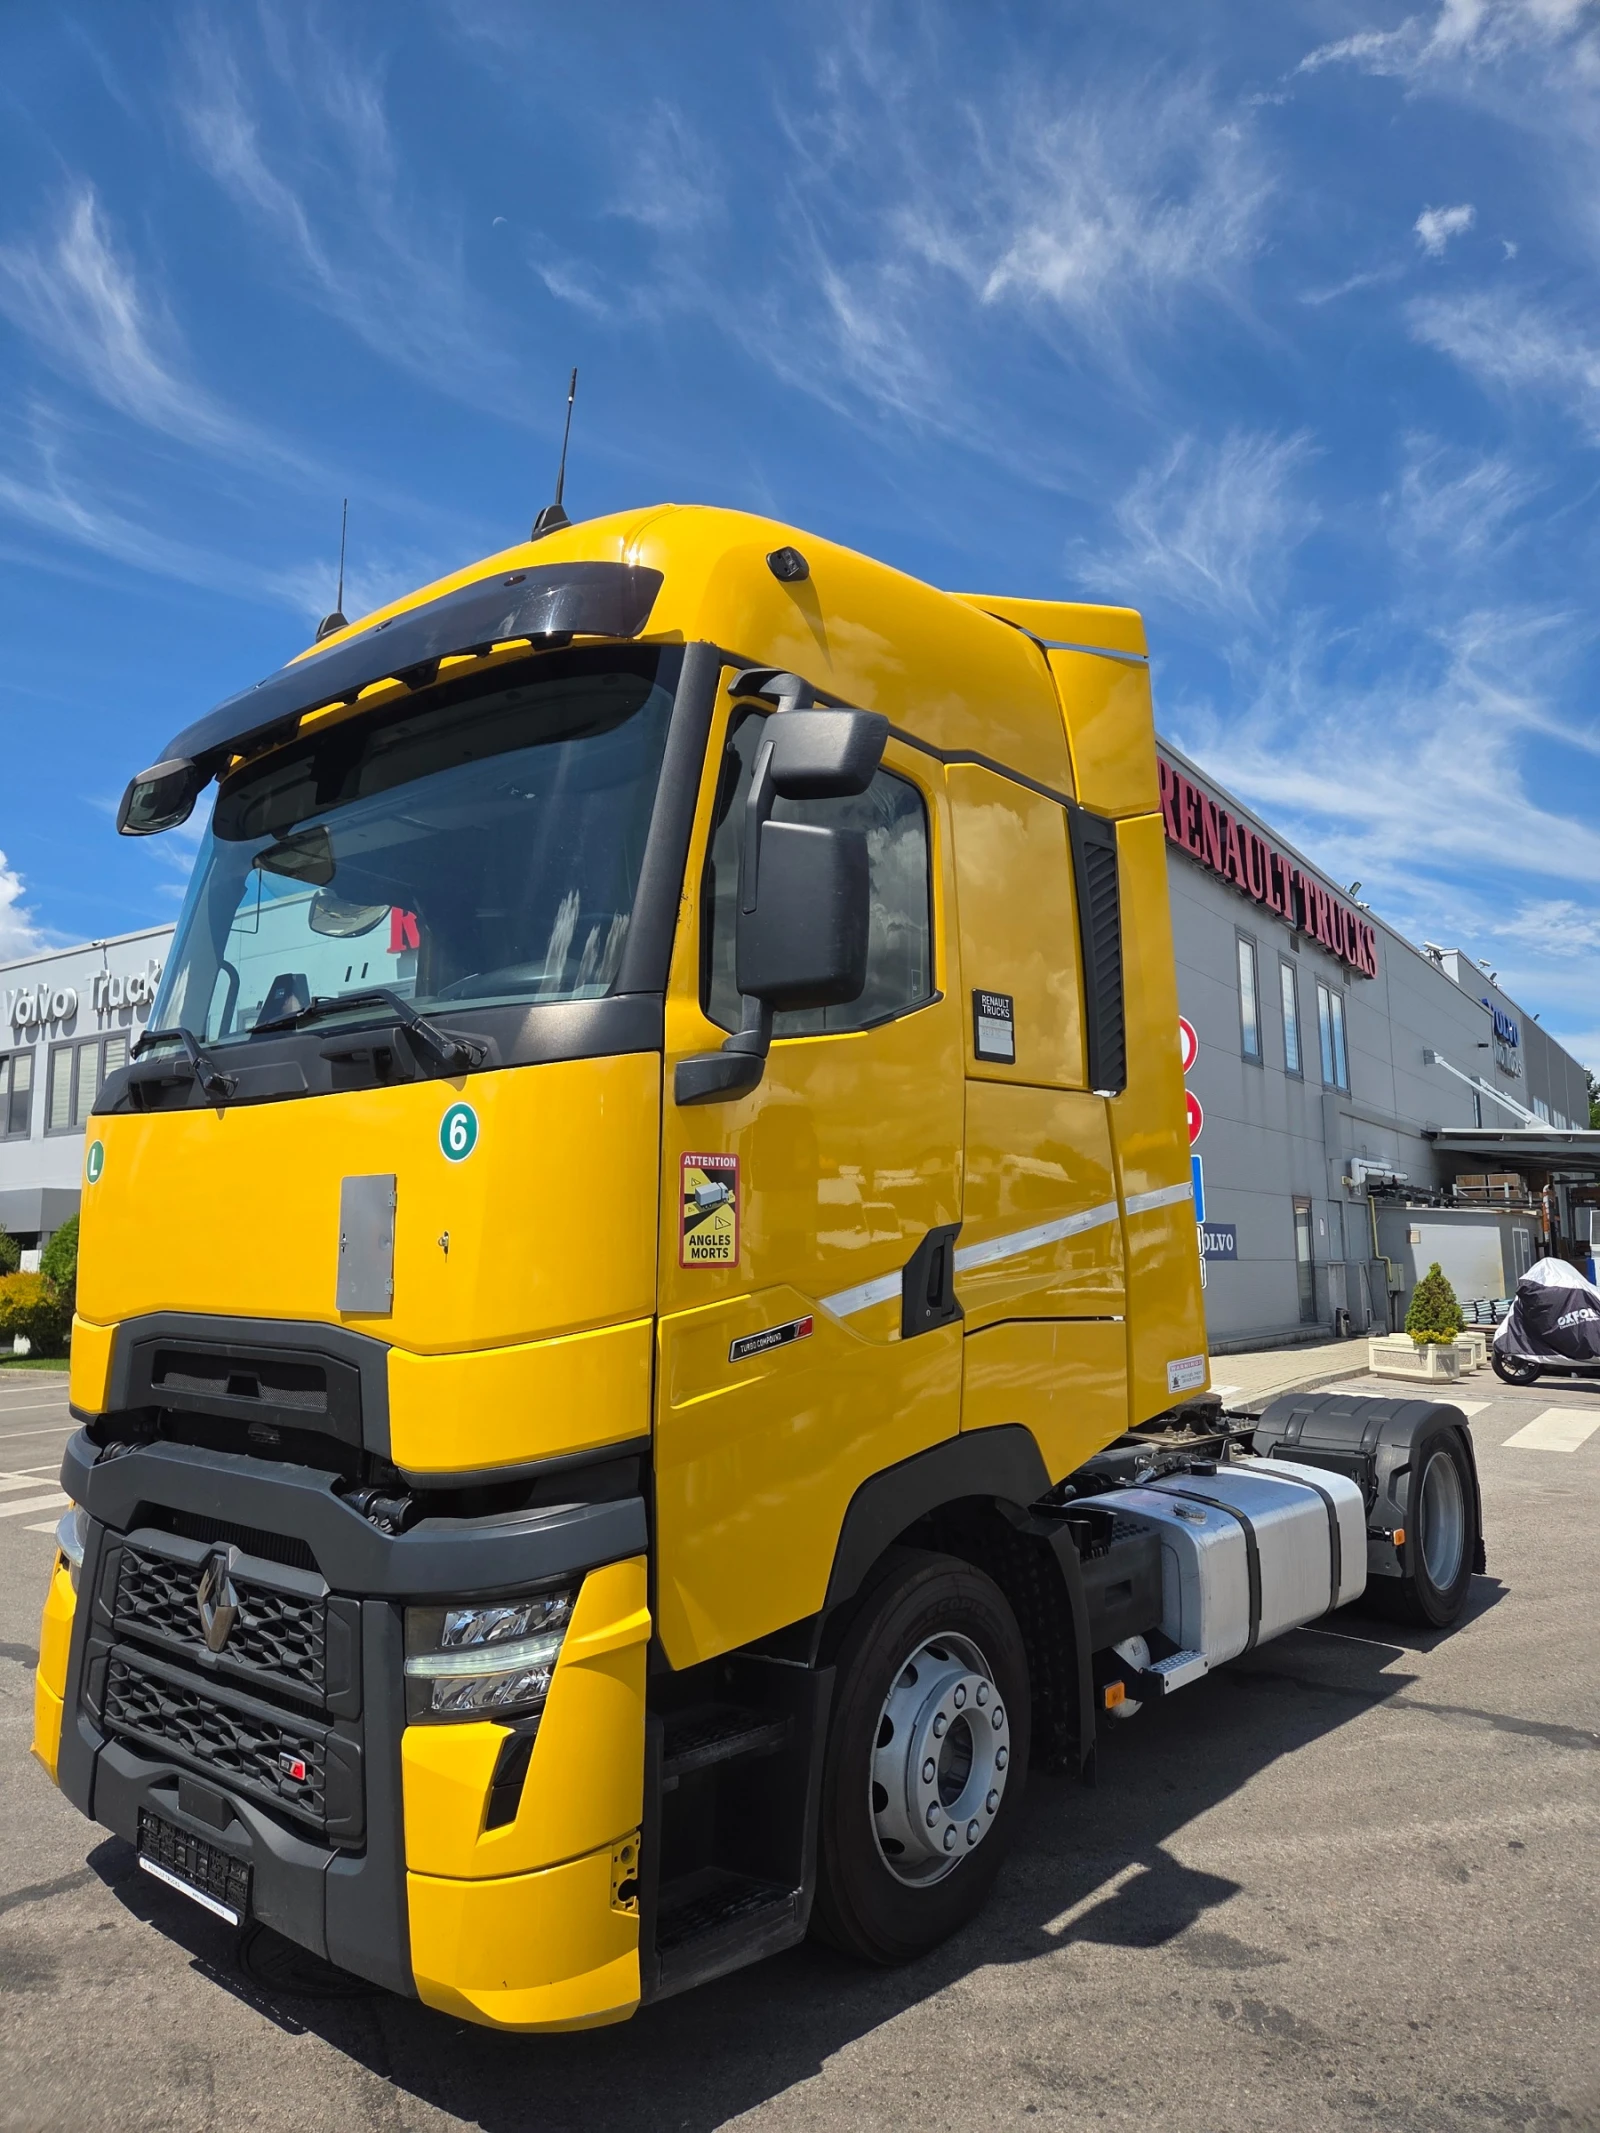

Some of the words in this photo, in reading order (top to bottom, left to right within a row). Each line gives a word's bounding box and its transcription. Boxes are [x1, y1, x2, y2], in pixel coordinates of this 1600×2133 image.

[1157, 756, 1294, 923] RENAULT
[1298, 870, 1378, 979] TRUCKS
[4, 983, 77, 1027] Volvo
[86, 959, 161, 1010] Truck
[981, 994, 1009, 1009] RENAULT
[982, 1004, 1010, 1018] TRUCKS
[449, 1113, 468, 1151] 6
[90, 1148, 98, 1176] L
[684, 1155, 736, 1167] ATTENTION
[689, 1234, 731, 1246] ANGLES
[1203, 1232, 1234, 1251] OLVO
[691, 1247, 729, 1259] MORTS
[740, 1341, 757, 1353] TURBO
[756, 1332, 782, 1347] COMPOUND
